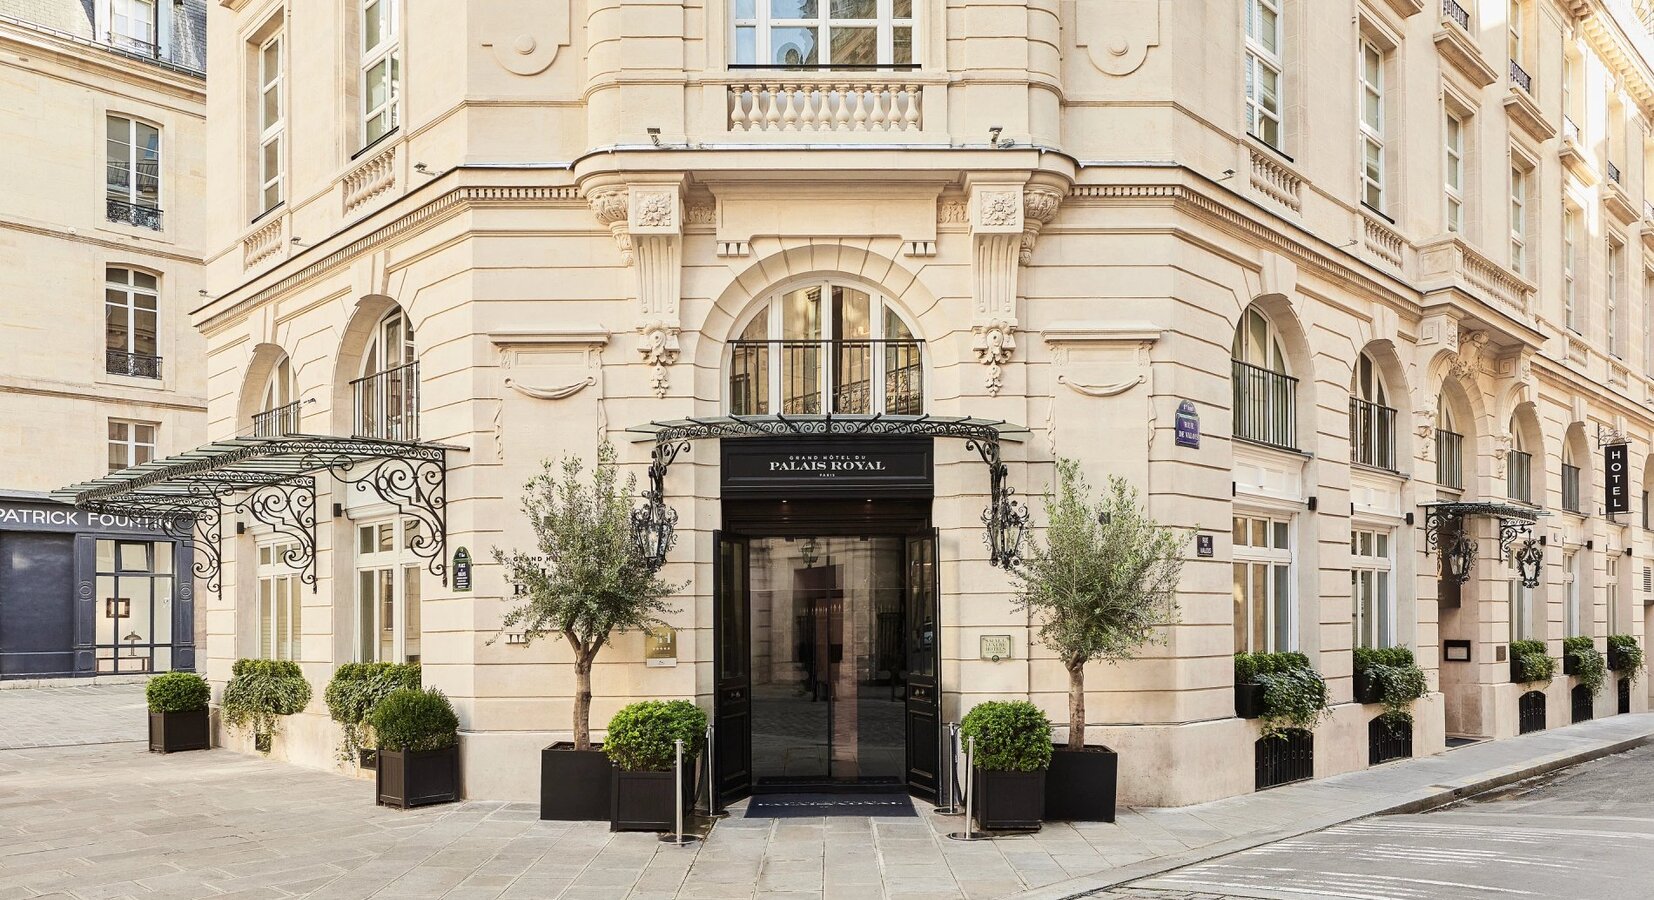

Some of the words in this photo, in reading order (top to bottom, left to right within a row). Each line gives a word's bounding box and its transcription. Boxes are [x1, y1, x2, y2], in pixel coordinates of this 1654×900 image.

[769, 461, 827, 471] PALAIS
[831, 461, 886, 471] ROYAL
[1611, 450, 1622, 507] HOTEL
